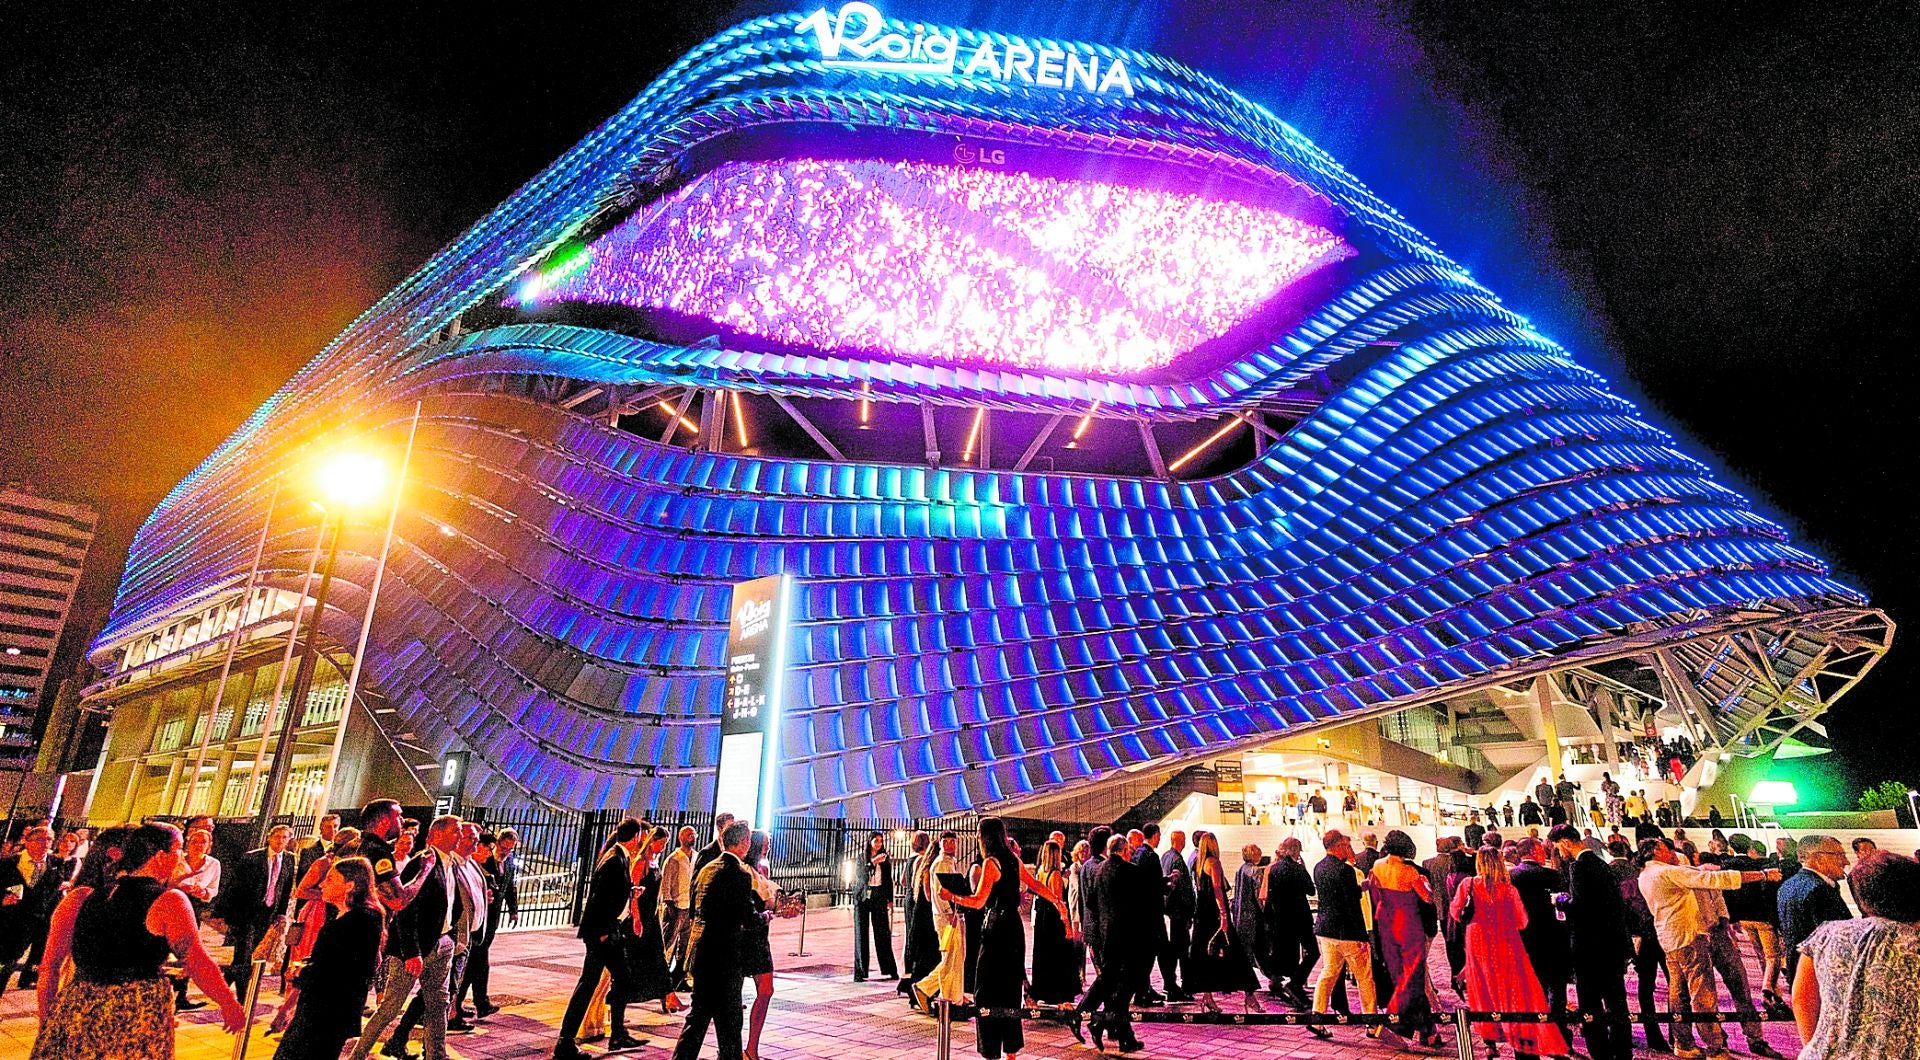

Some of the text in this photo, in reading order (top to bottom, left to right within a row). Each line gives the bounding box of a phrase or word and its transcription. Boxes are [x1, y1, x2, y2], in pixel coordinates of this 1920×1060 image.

[795, 1, 1136, 98] Roig ARENA
[739, 618, 769, 641] ARENA
[442, 759, 458, 786] B
